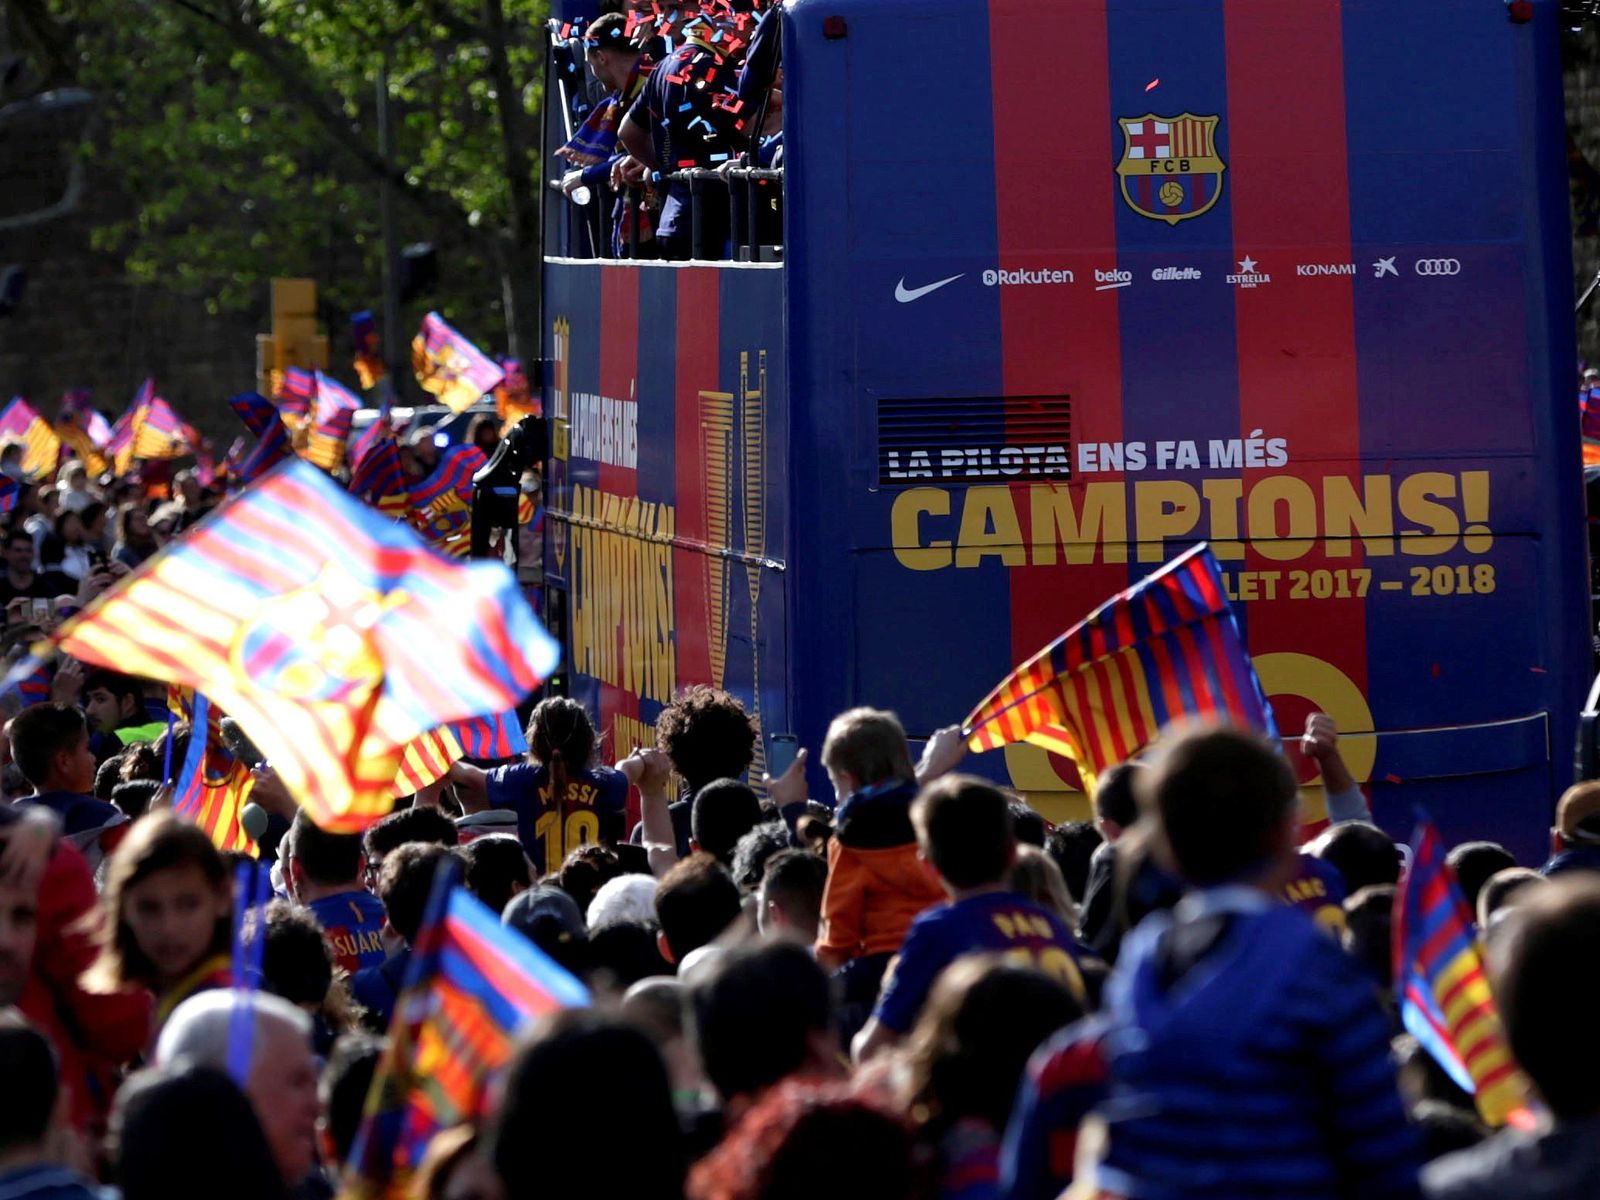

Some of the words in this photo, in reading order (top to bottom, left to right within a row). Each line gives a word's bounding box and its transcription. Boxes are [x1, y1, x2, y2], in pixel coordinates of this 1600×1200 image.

[998, 268, 1074, 284] Rakuten
[1094, 269, 1132, 282] beko
[1151, 267, 1202, 281] Gillette
[1297, 264, 1356, 275] KONAMI
[1226, 274, 1271, 284] ESTRELLA
[888, 450, 933, 478] LA
[941, 447, 1070, 477] PILOTA
[1078, 441, 1147, 473] ENS
[1156, 440, 1200, 470] FA
[1208, 429, 1288, 469] MÉS
[890, 470, 1495, 571] CAMPIONS!
[1219, 569, 1281, 601] LET
[1289, 568, 1372, 600] 2017
[1410, 563, 1496, 596] 2018
[538, 782, 599, 806] MSSI
